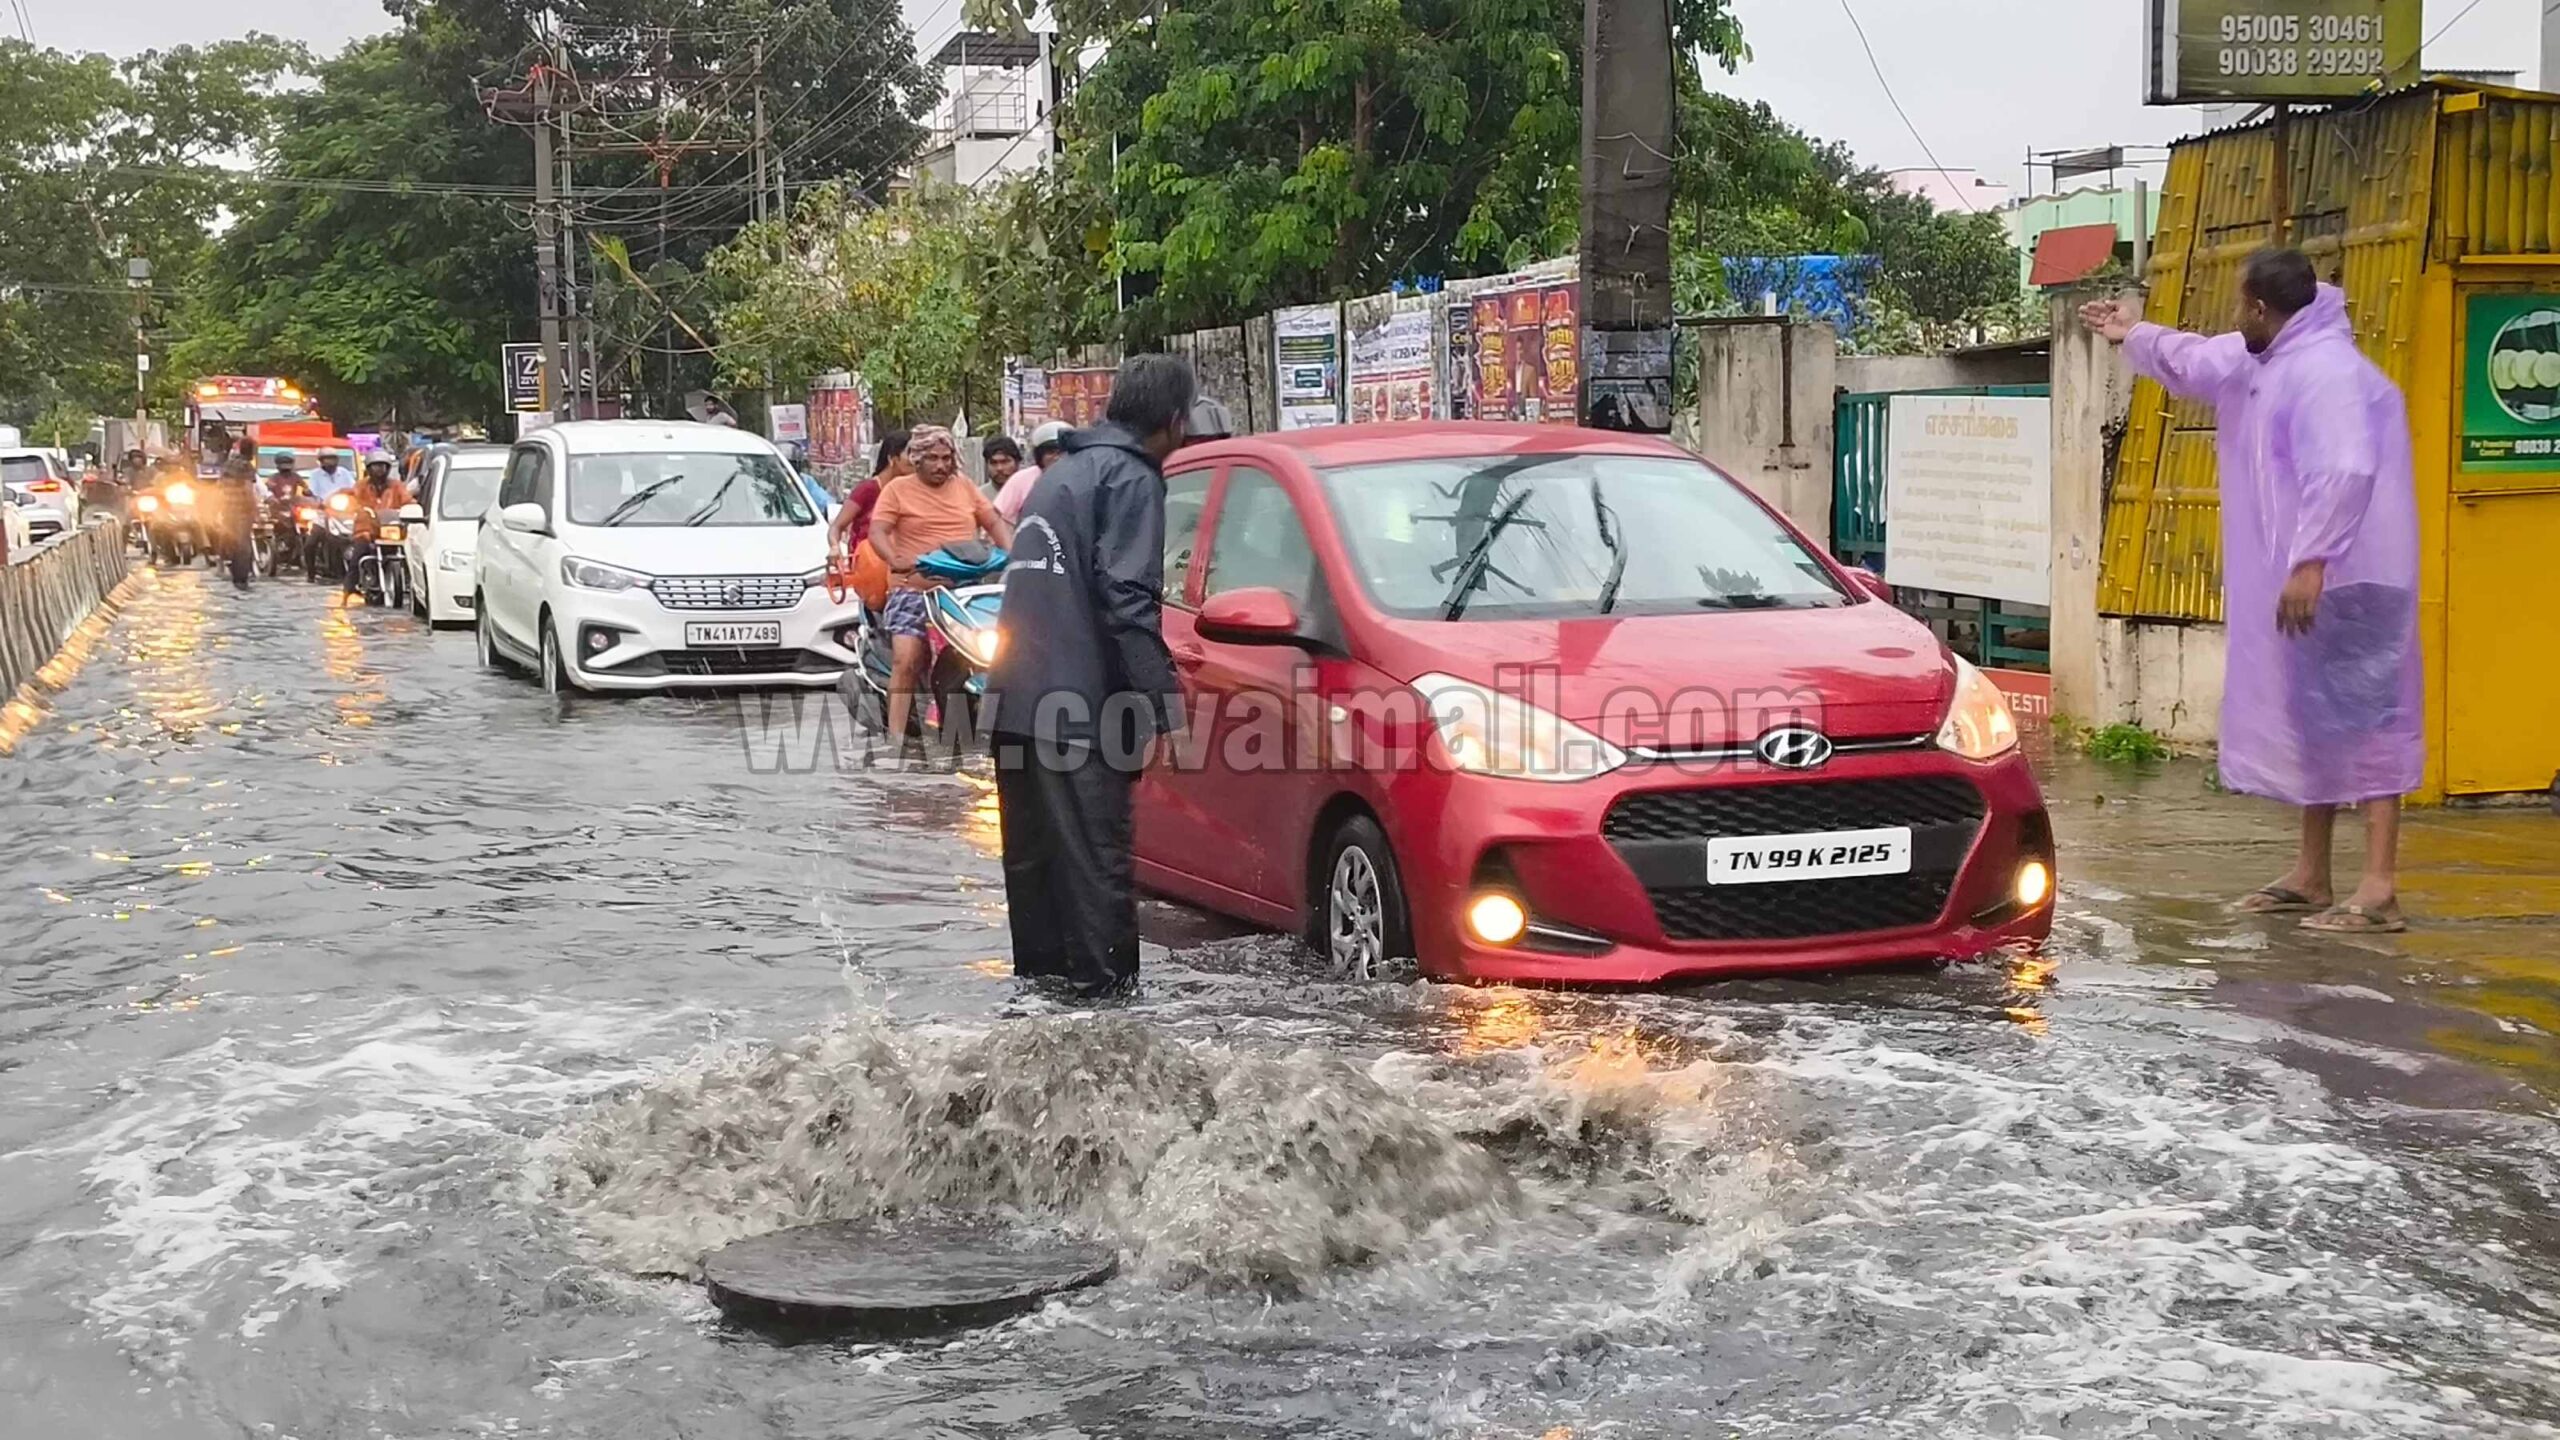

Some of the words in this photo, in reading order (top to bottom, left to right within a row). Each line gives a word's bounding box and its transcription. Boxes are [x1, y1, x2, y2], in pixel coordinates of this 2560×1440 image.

[2220, 15, 2300, 43] 95005
[2308, 14, 2384, 42] 30461
[2218, 47, 2299, 75] 90038
[2306, 47, 2384, 75] 29292
[2515, 439, 2551, 454] 90038
[696, 627, 778, 641] TN41AY7489
[1729, 851, 1763, 870] TN
[1767, 848, 1802, 868] 99
[1807, 847, 1825, 866] K
[1830, 843, 1892, 865] 2125
